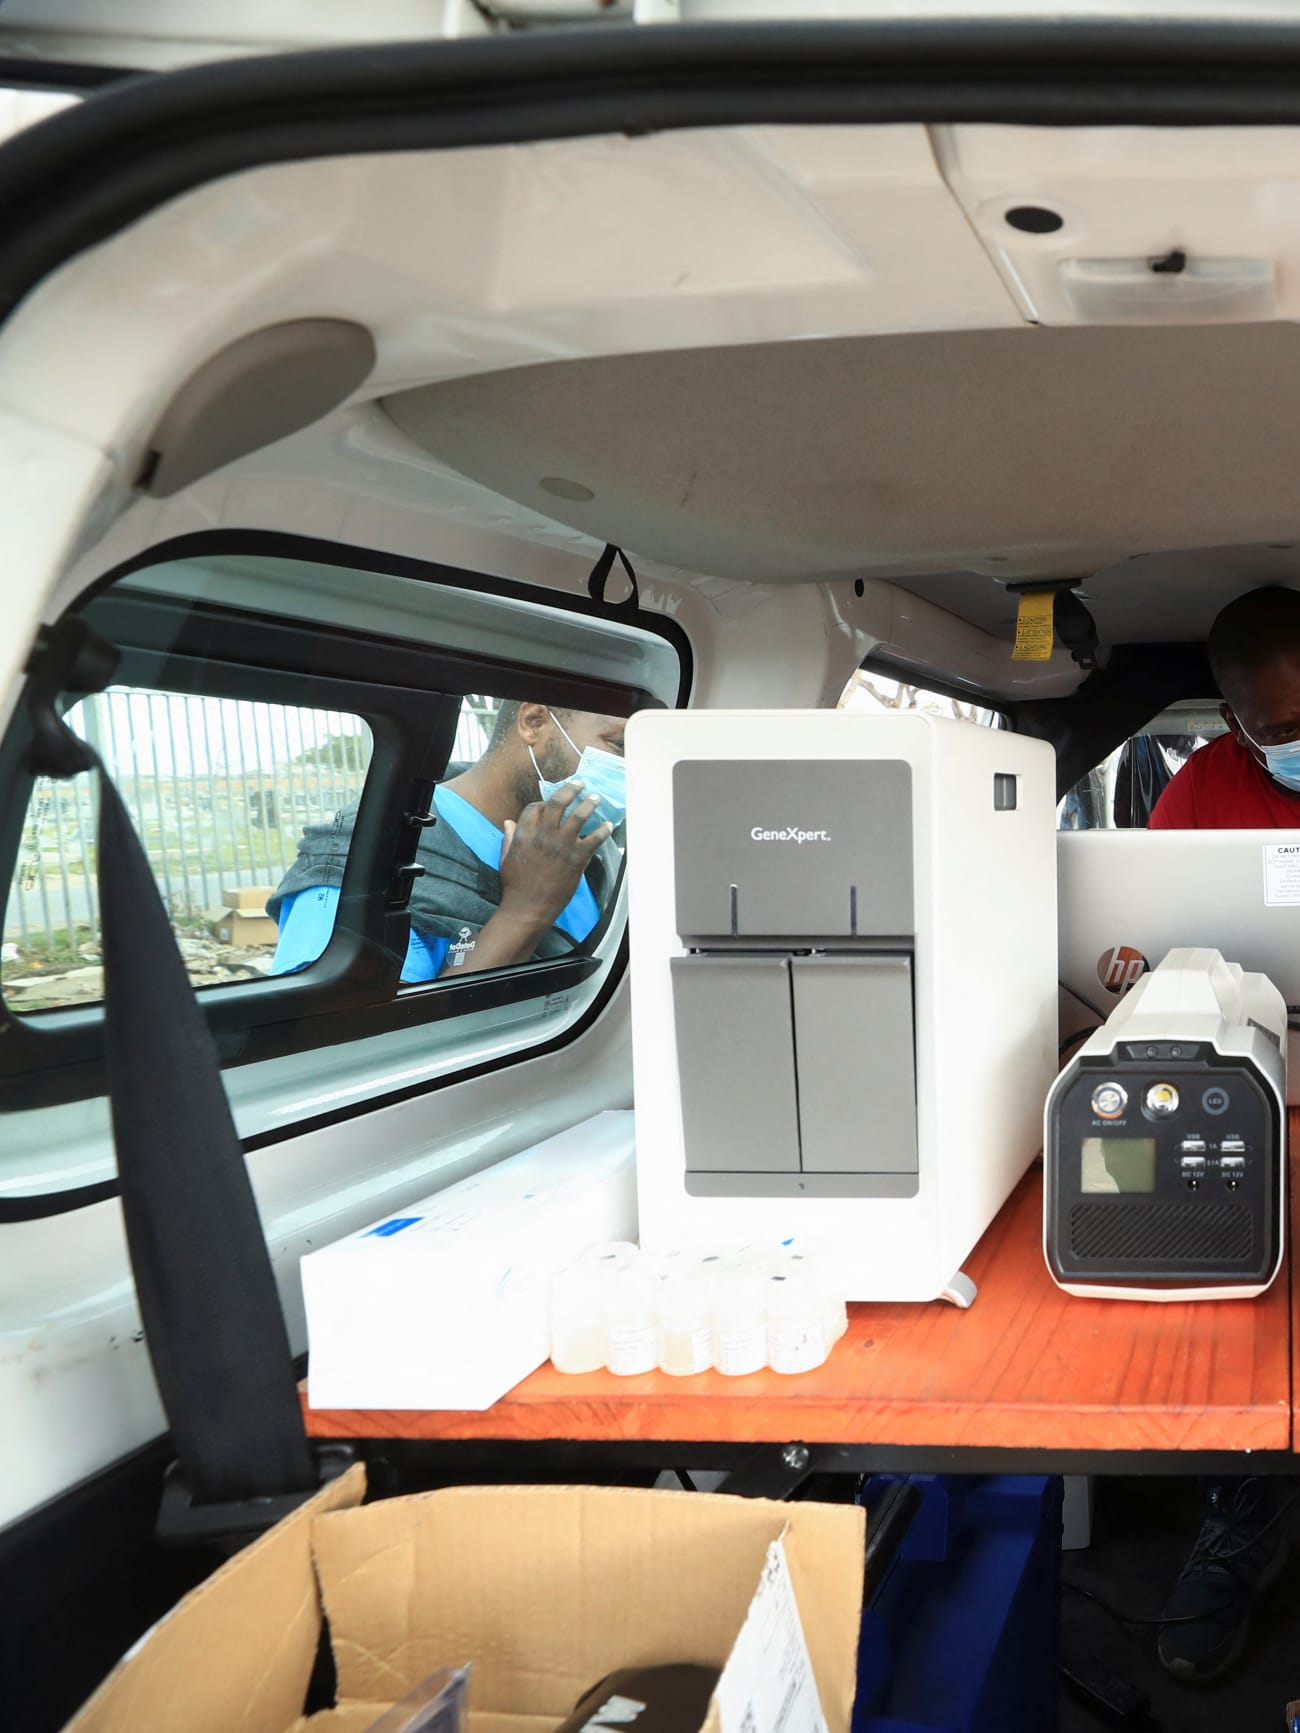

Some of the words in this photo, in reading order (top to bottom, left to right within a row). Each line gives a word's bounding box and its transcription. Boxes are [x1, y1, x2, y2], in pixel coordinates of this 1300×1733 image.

[751, 826, 829, 844] GeneXpert
[1104, 945, 1145, 996] hp
[1092, 1119, 1101, 1127] AC
